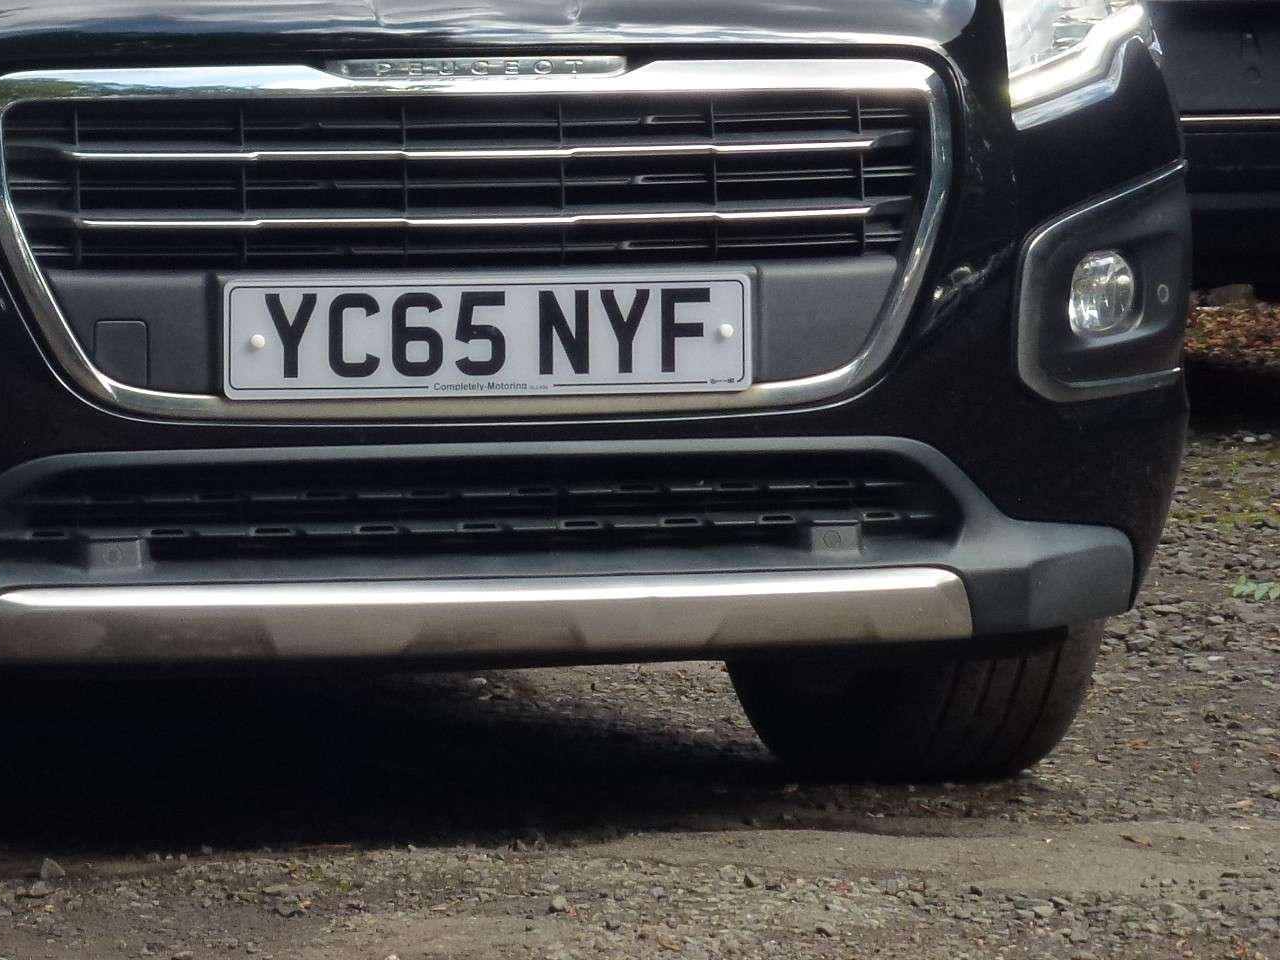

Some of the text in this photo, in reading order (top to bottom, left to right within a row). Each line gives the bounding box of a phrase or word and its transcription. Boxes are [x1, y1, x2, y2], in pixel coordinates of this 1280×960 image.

[375, 59, 584, 77] PEUGEOT
[264, 287, 712, 379] YC65 NYF
